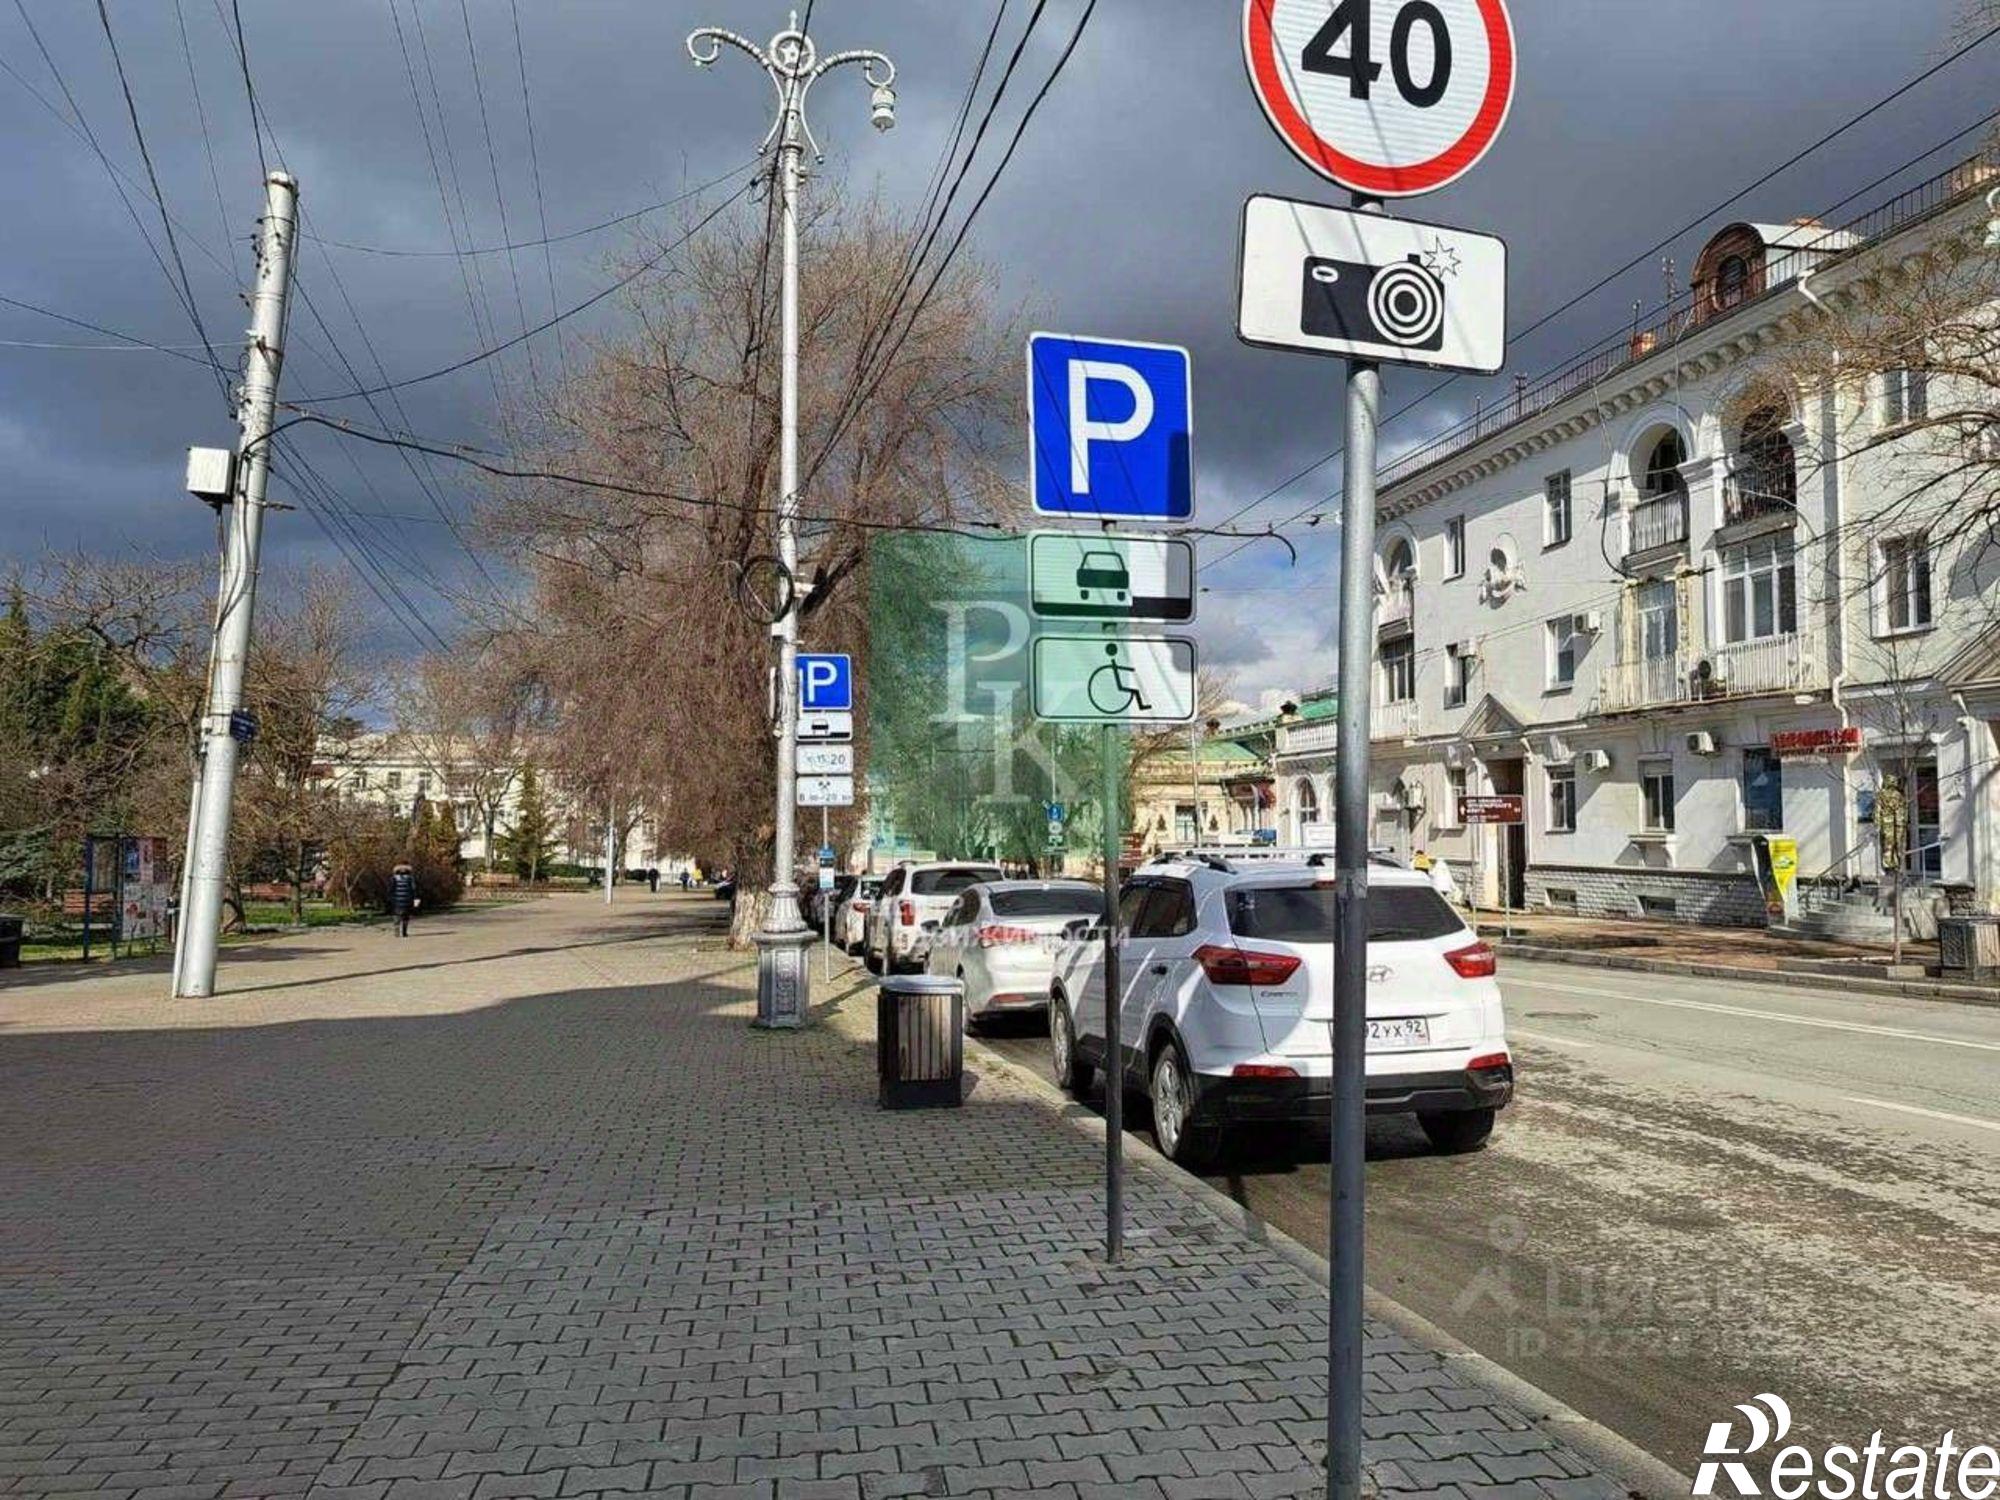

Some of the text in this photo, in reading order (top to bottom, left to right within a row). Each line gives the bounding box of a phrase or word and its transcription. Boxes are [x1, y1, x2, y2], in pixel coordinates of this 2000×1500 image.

[1301, 0, 1452, 108] 40
[1068, 359, 1154, 494] P
[807, 660, 838, 703] P
